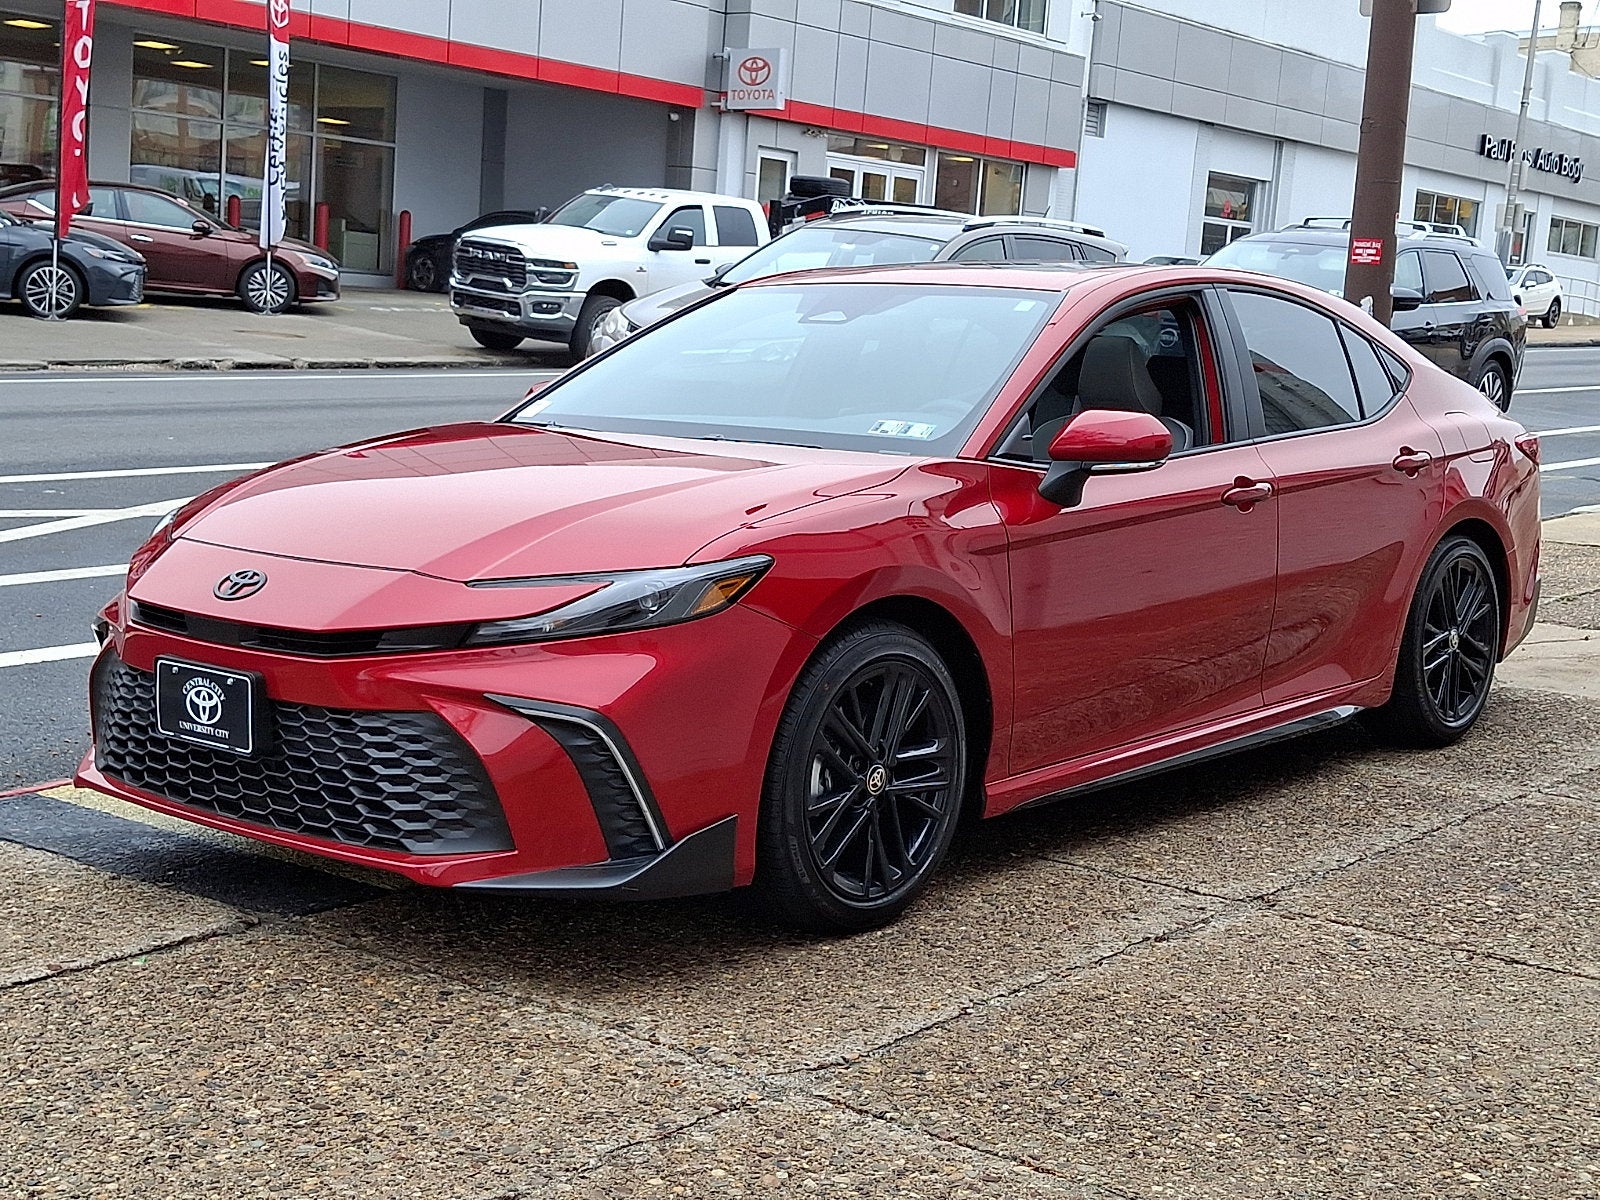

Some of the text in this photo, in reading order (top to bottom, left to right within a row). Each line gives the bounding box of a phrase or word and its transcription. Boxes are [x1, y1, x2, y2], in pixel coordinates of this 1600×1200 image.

[731, 89, 775, 100] TOYOTA
[1481, 133, 1508, 161] Paul
[1535, 147, 1560, 173] Auto
[1560, 153, 1585, 184] Body
[472, 249, 506, 261] RAM
[182, 677, 226, 701] CENTRAL CITY
[178, 720, 230, 740] UNIVERSITY CITY
